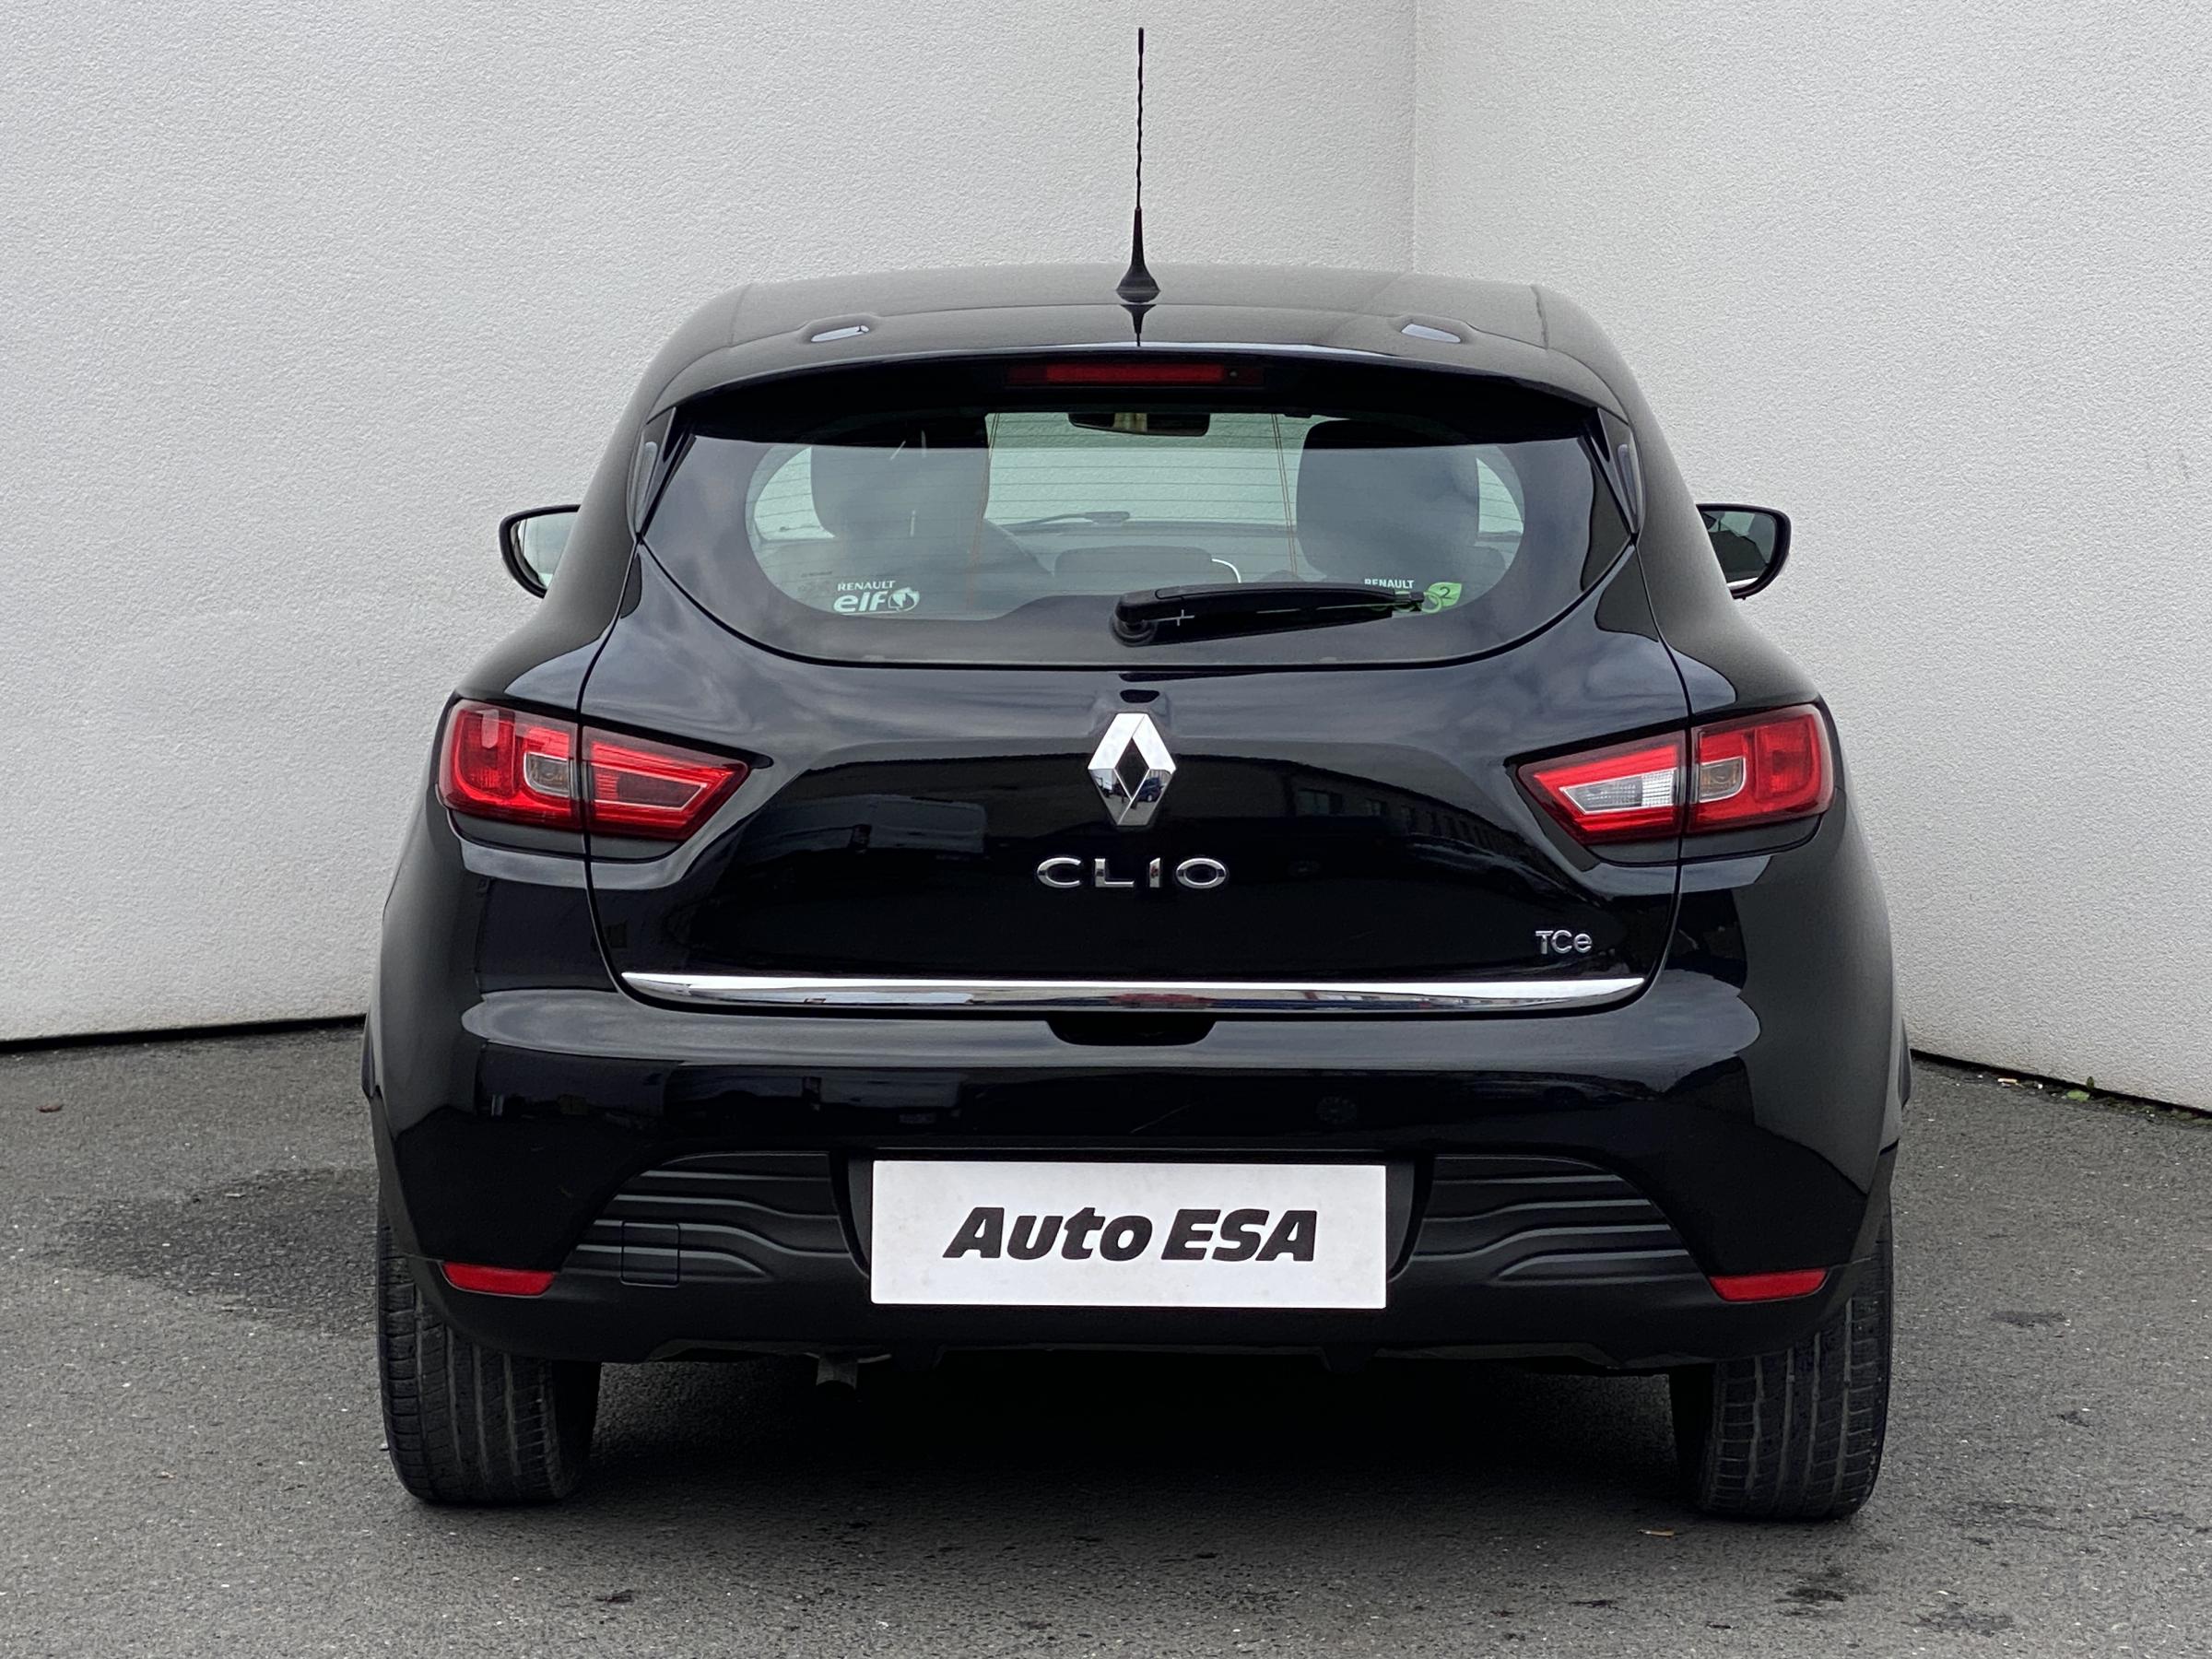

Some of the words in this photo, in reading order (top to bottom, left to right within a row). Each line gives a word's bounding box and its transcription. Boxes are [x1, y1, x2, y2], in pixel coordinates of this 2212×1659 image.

[837, 580, 896, 591] RENAULT
[832, 591, 888, 613] elf
[1036, 856, 1227, 889] CLIO
[1535, 929, 1593, 955] TCe
[942, 1206, 1154, 1262] Auto
[1160, 1208, 1318, 1262] ESA
